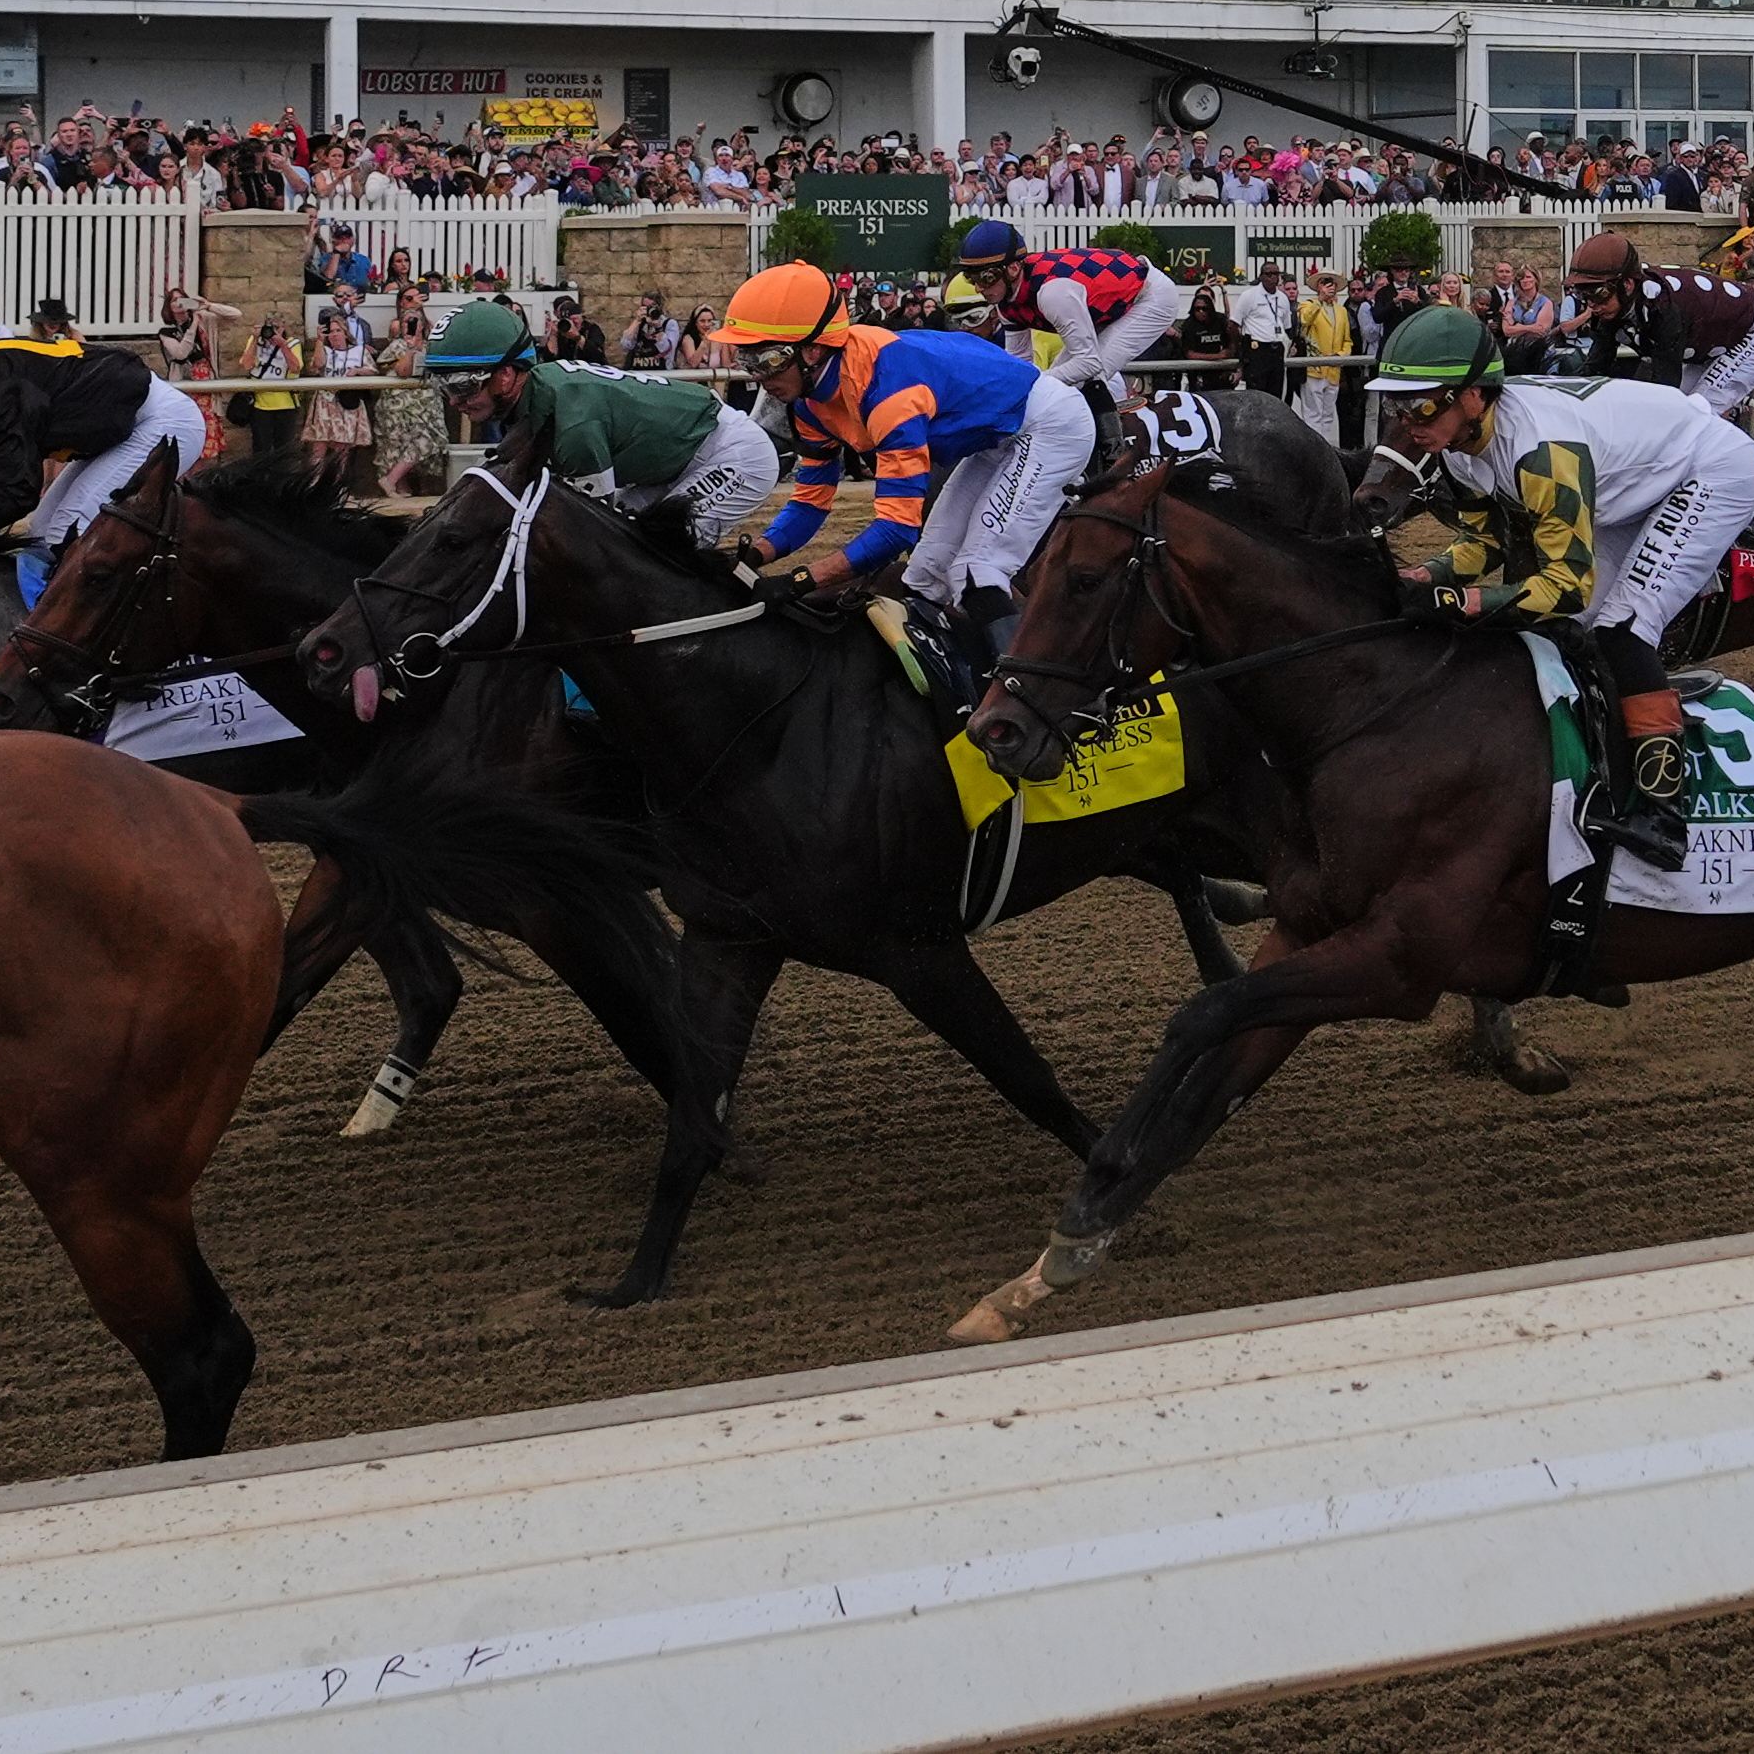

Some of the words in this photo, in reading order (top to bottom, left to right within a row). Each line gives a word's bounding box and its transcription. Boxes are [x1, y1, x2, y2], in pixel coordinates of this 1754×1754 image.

[366, 72, 454, 92] LOBSTER
[462, 72, 501, 92] HUT
[525, 73, 588, 85] COOKIES
[592, 74, 603, 85] &
[526, 88, 549, 98] ICE
[554, 88, 603, 98] CREAM
[1615, 184, 1633, 193] POLICE
[816, 199, 929, 215] PREAKNESS
[858, 217, 885, 234] 151
[1167, 248, 1211, 267] 1/ST
[1704, 358, 1728, 386] JEFF
[1130, 390, 1208, 456] 13
[1014, 498, 1026, 516] ICE
[1024, 463, 1044, 497] CREAM
[1628, 536, 1662, 590] JEFF
[208, 699, 247, 726] 151
[1066, 763, 1100, 793] 151
[1700, 858, 1734, 885] 151
